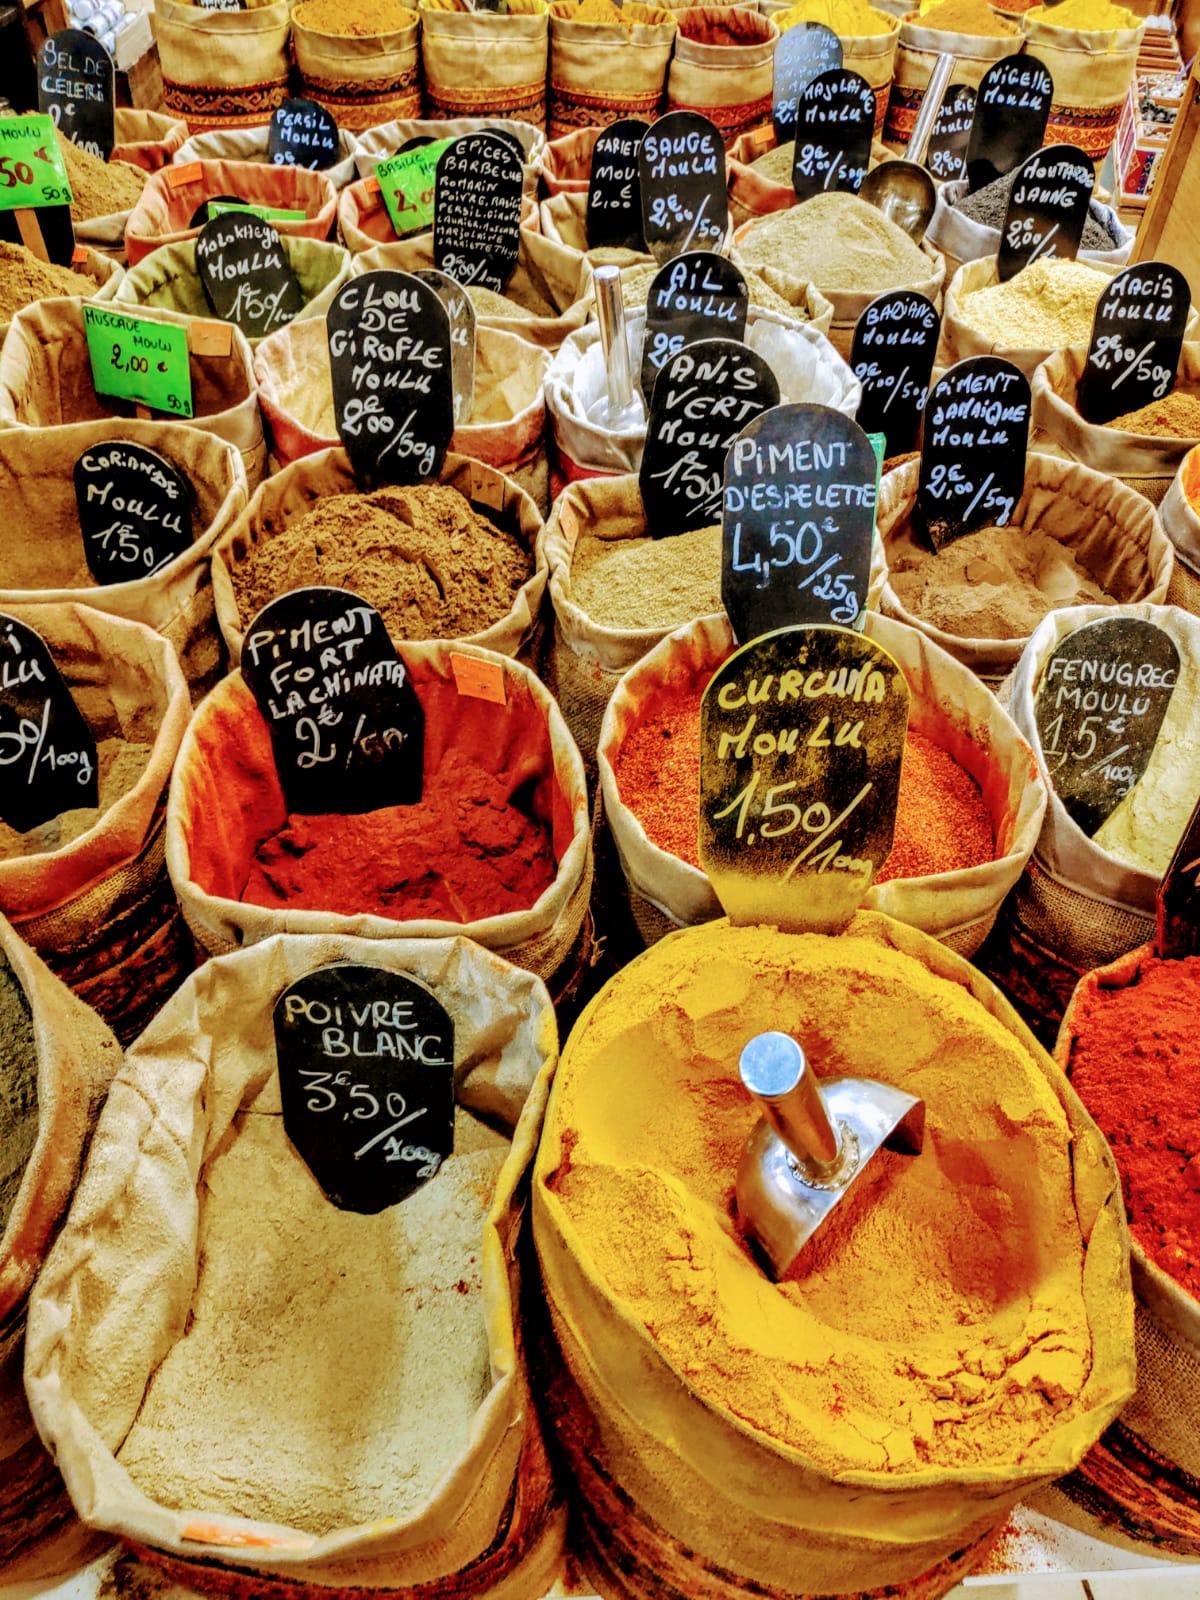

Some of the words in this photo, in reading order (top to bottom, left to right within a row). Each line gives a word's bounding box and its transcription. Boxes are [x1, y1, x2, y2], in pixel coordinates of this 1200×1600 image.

[983, 86, 1042, 111] MOULU
[805, 104, 861, 123] MOULU
[281, 126, 334, 150] MOULU
[596, 138, 641, 157] SARIET
[644, 131, 715, 162] SAUGE
[444, 156, 522, 183] BARBECUE
[596, 165, 640, 181] MOU
[651, 155, 717, 179] MOULU
[1014, 185, 1078, 208] JAUNE
[208, 252, 282, 281] MOULU
[339, 283, 421, 314] CLOU
[657, 284, 737, 322] MOULU
[1102, 298, 1173, 322] MOULU
[359, 307, 409, 333] DE
[862, 326, 926, 345] MOULU
[111, 343, 148, 374] 2,00
[351, 360, 431, 394] MOULU
[666, 386, 764, 421] VERT
[658, 418, 739, 449] MOUL
[933, 425, 1008, 447] MOULU
[87, 481, 182, 534] MOULU
[724, 483, 876, 512] D'ESPELETTE
[718, 661, 885, 710] CURCUMA
[1048, 658, 1176, 689] FENUGREC
[1055, 687, 1150, 715] MOULU
[717, 714, 864, 759] MOULU
[322, 1027, 453, 1065] BLANC
